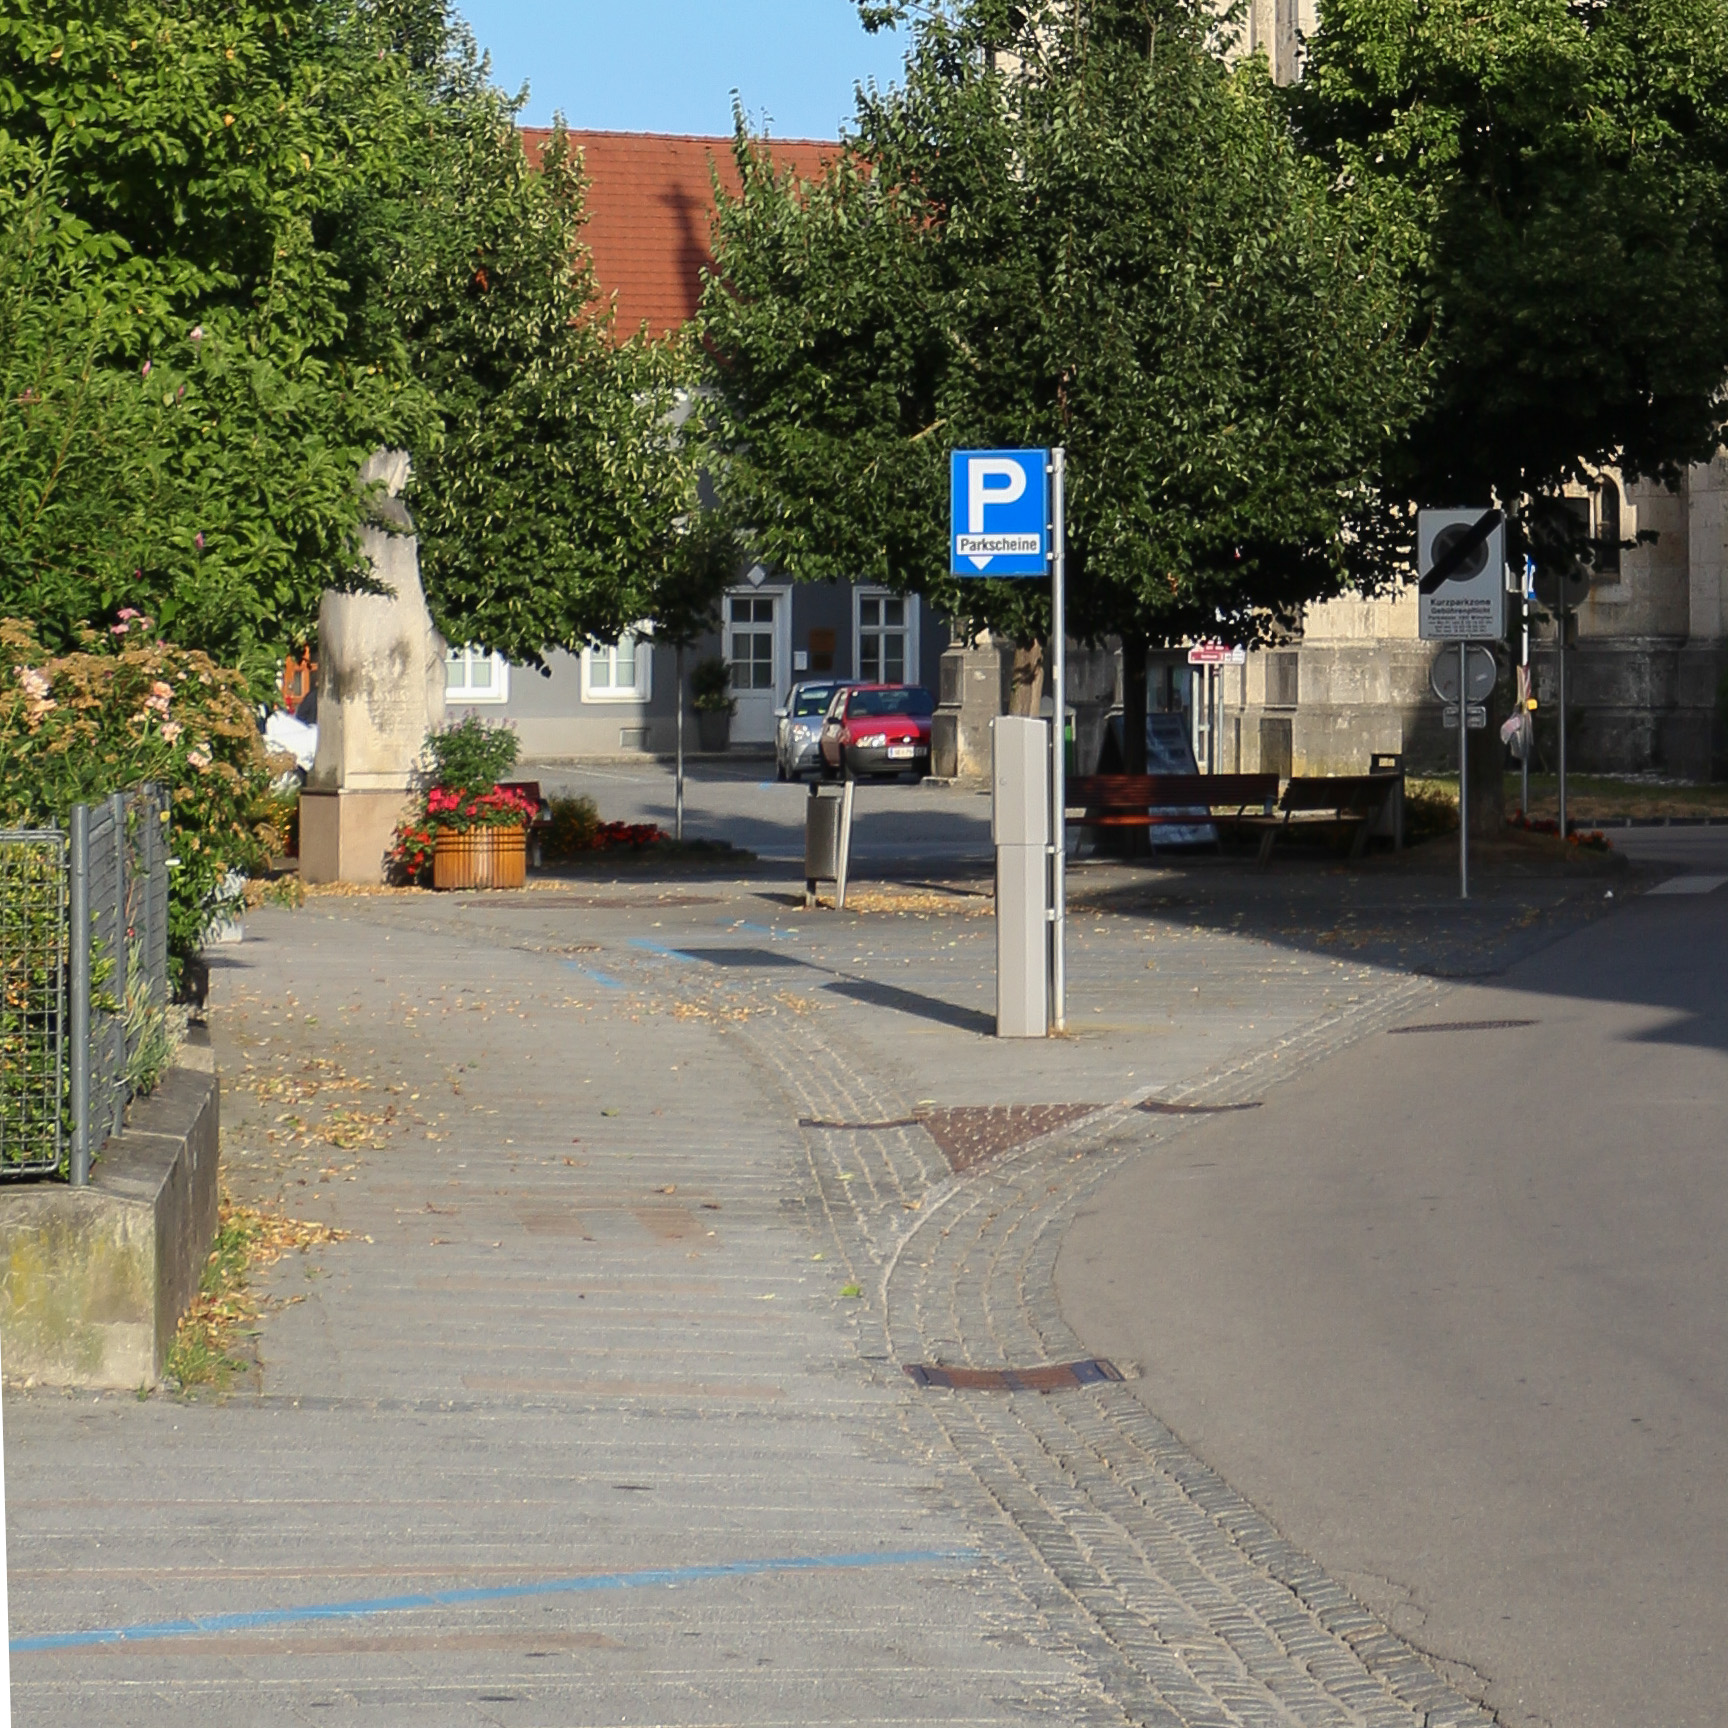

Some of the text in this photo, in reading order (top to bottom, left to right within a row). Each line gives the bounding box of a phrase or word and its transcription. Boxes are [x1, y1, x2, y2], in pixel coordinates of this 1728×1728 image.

[968, 458, 1027, 533] P
[960, 537, 1037, 552] Parkscheine
[1430, 598, 1491, 607] Kurzparkzone
